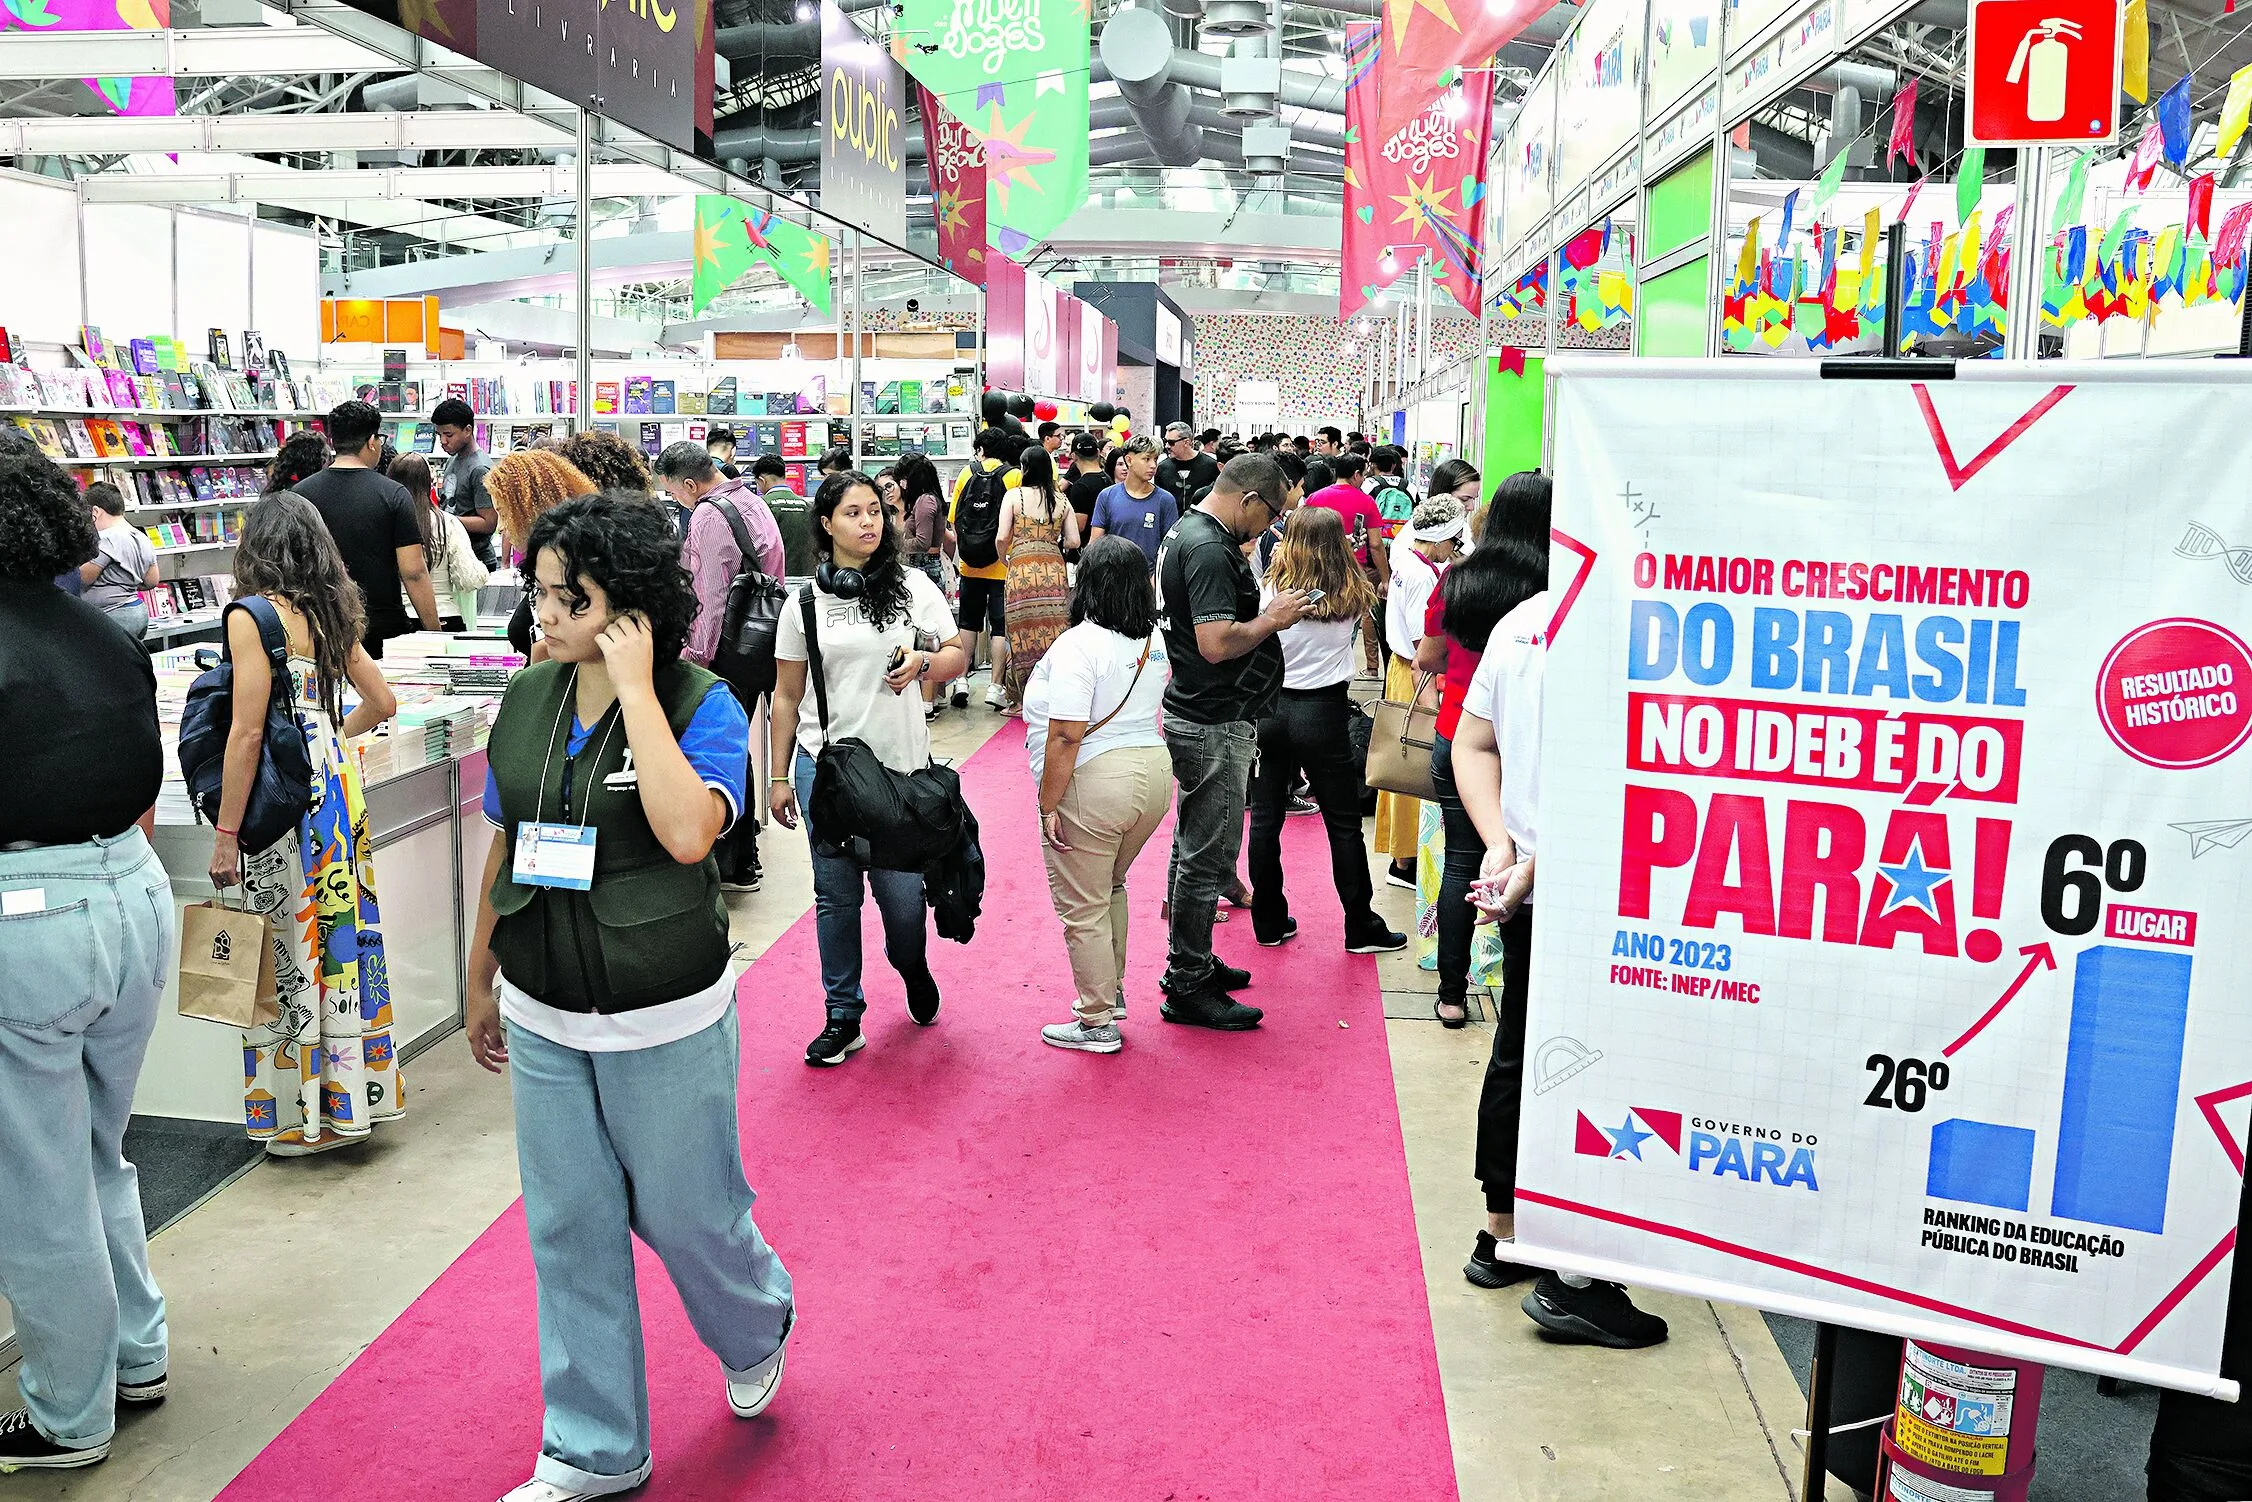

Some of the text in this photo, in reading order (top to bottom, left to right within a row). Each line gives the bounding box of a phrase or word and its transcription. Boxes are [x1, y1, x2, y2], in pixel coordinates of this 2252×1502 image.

[831, 66, 899, 173] public
[1633, 552, 2030, 609] O MAIOR CRESCIMENTO
[1628, 600, 2027, 707] DO BRASIL
[2120, 663, 2233, 700] RESULTADO
[2124, 691, 2238, 728] HISTÓRICO
[1641, 703, 2005, 793] NO IDEB É DO
[1618, 779, 2013, 963] PARÁ!
[1612, 930, 1732, 971] ANO 2023
[2115, 916, 2186, 942] LUGAR
[1610, 964, 1761, 1004] FONTE: INEP/MEC
[1691, 1117, 1818, 1146] GOVERNO DO
[1921, 1229, 2079, 1273] PÚBLICA DO BRASIL
[1923, 1208, 2125, 1258] RANKING DA EDUCAÇÃO
